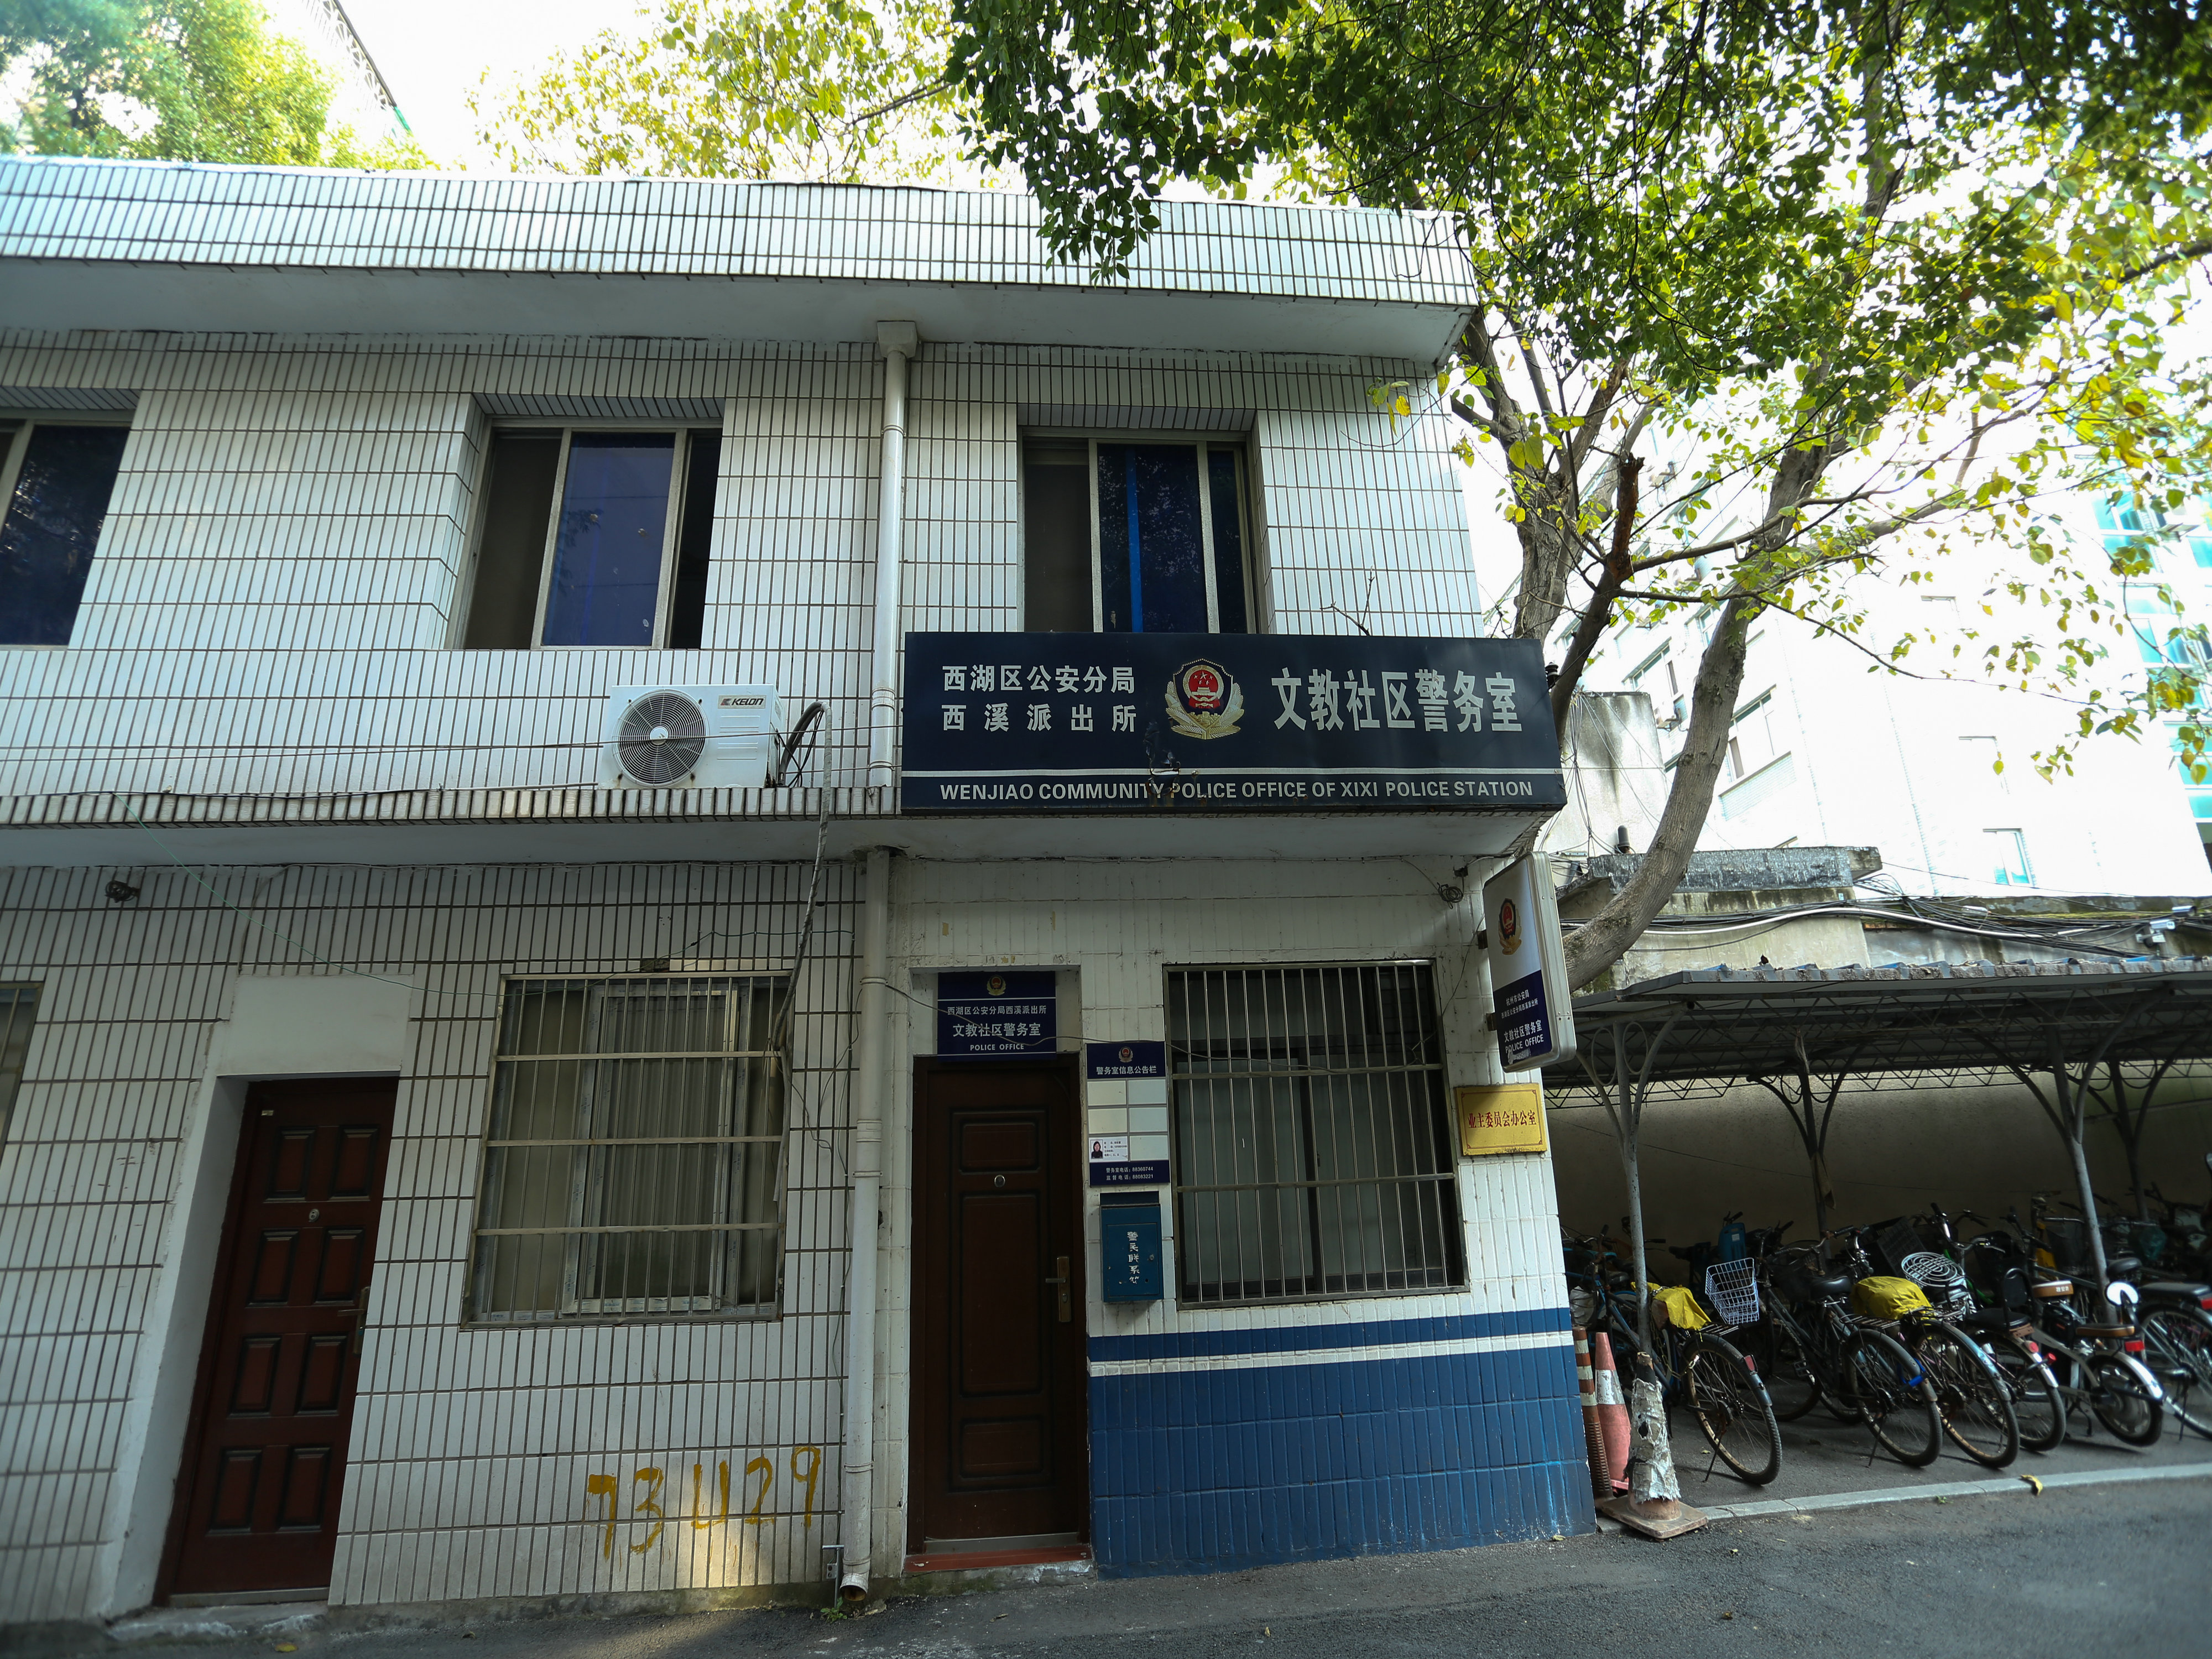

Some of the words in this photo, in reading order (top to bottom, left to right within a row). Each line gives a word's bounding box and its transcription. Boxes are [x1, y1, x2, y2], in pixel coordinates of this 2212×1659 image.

[942, 665, 1135, 693] 西湖区公安分局
[1271, 667, 1522, 733] 文教社区警务室
[941, 703, 1136, 732] 西溪派出所
[940, 784, 1034, 801] WENJIAO
[1039, 782, 1165, 800] COMMUNITY
[1170, 782, 1237, 799] POLICE
[1241, 781, 1306, 798] OFFICE
[1312, 781, 1335, 797] OF
[1340, 781, 1379, 797] XIXI
[1386, 781, 1449, 797] POLICE
[1454, 781, 1533, 796] STATION
[1506, 989, 1530, 1006] 杭州市公安局
[947, 1006, 1046, 1015] 西湖区公安分局西溪派出所
[953, 1022, 1041, 1037] 文教社区警务室
[1504, 1019, 1542, 1043] 文教社区警务室
[1505, 1041, 1523, 1053] POLICE
[1525, 1034, 1544, 1047] OFFICE
[1097, 1066, 1157, 1075] 警务室信息公告栏
[1468, 1110, 1536, 1128] 业主委员会办公室
